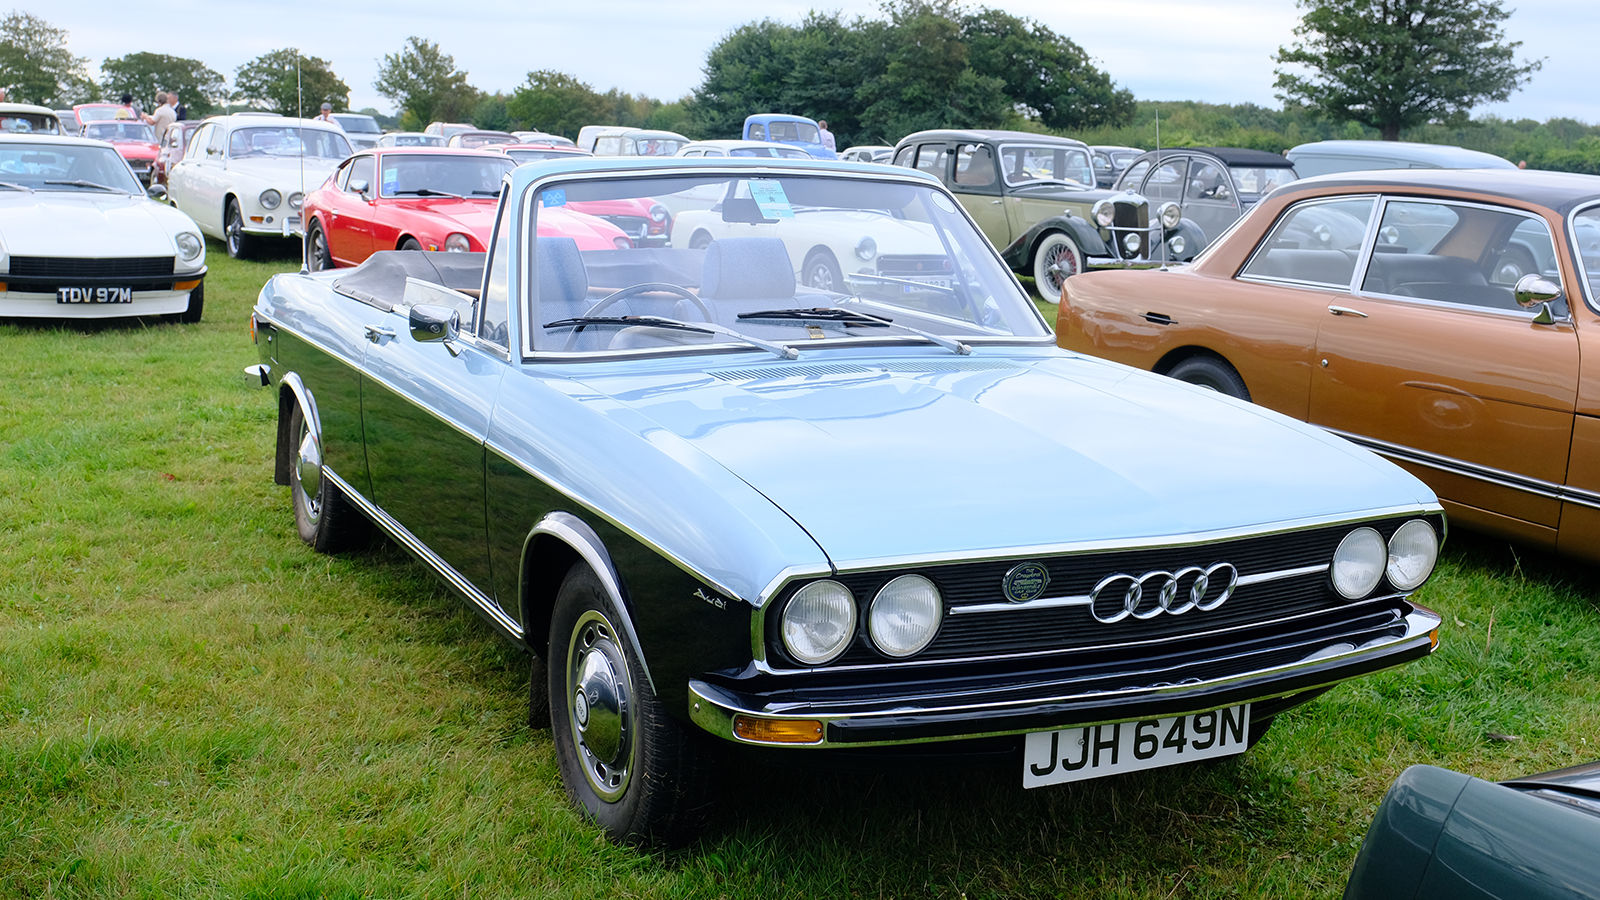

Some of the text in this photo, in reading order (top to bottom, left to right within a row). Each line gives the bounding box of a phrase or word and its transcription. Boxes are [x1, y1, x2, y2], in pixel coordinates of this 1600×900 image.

[58, 287, 131, 303] TDV 97M
[692, 588, 728, 610] Audi
[1030, 704, 1246, 776] JJH 649N
